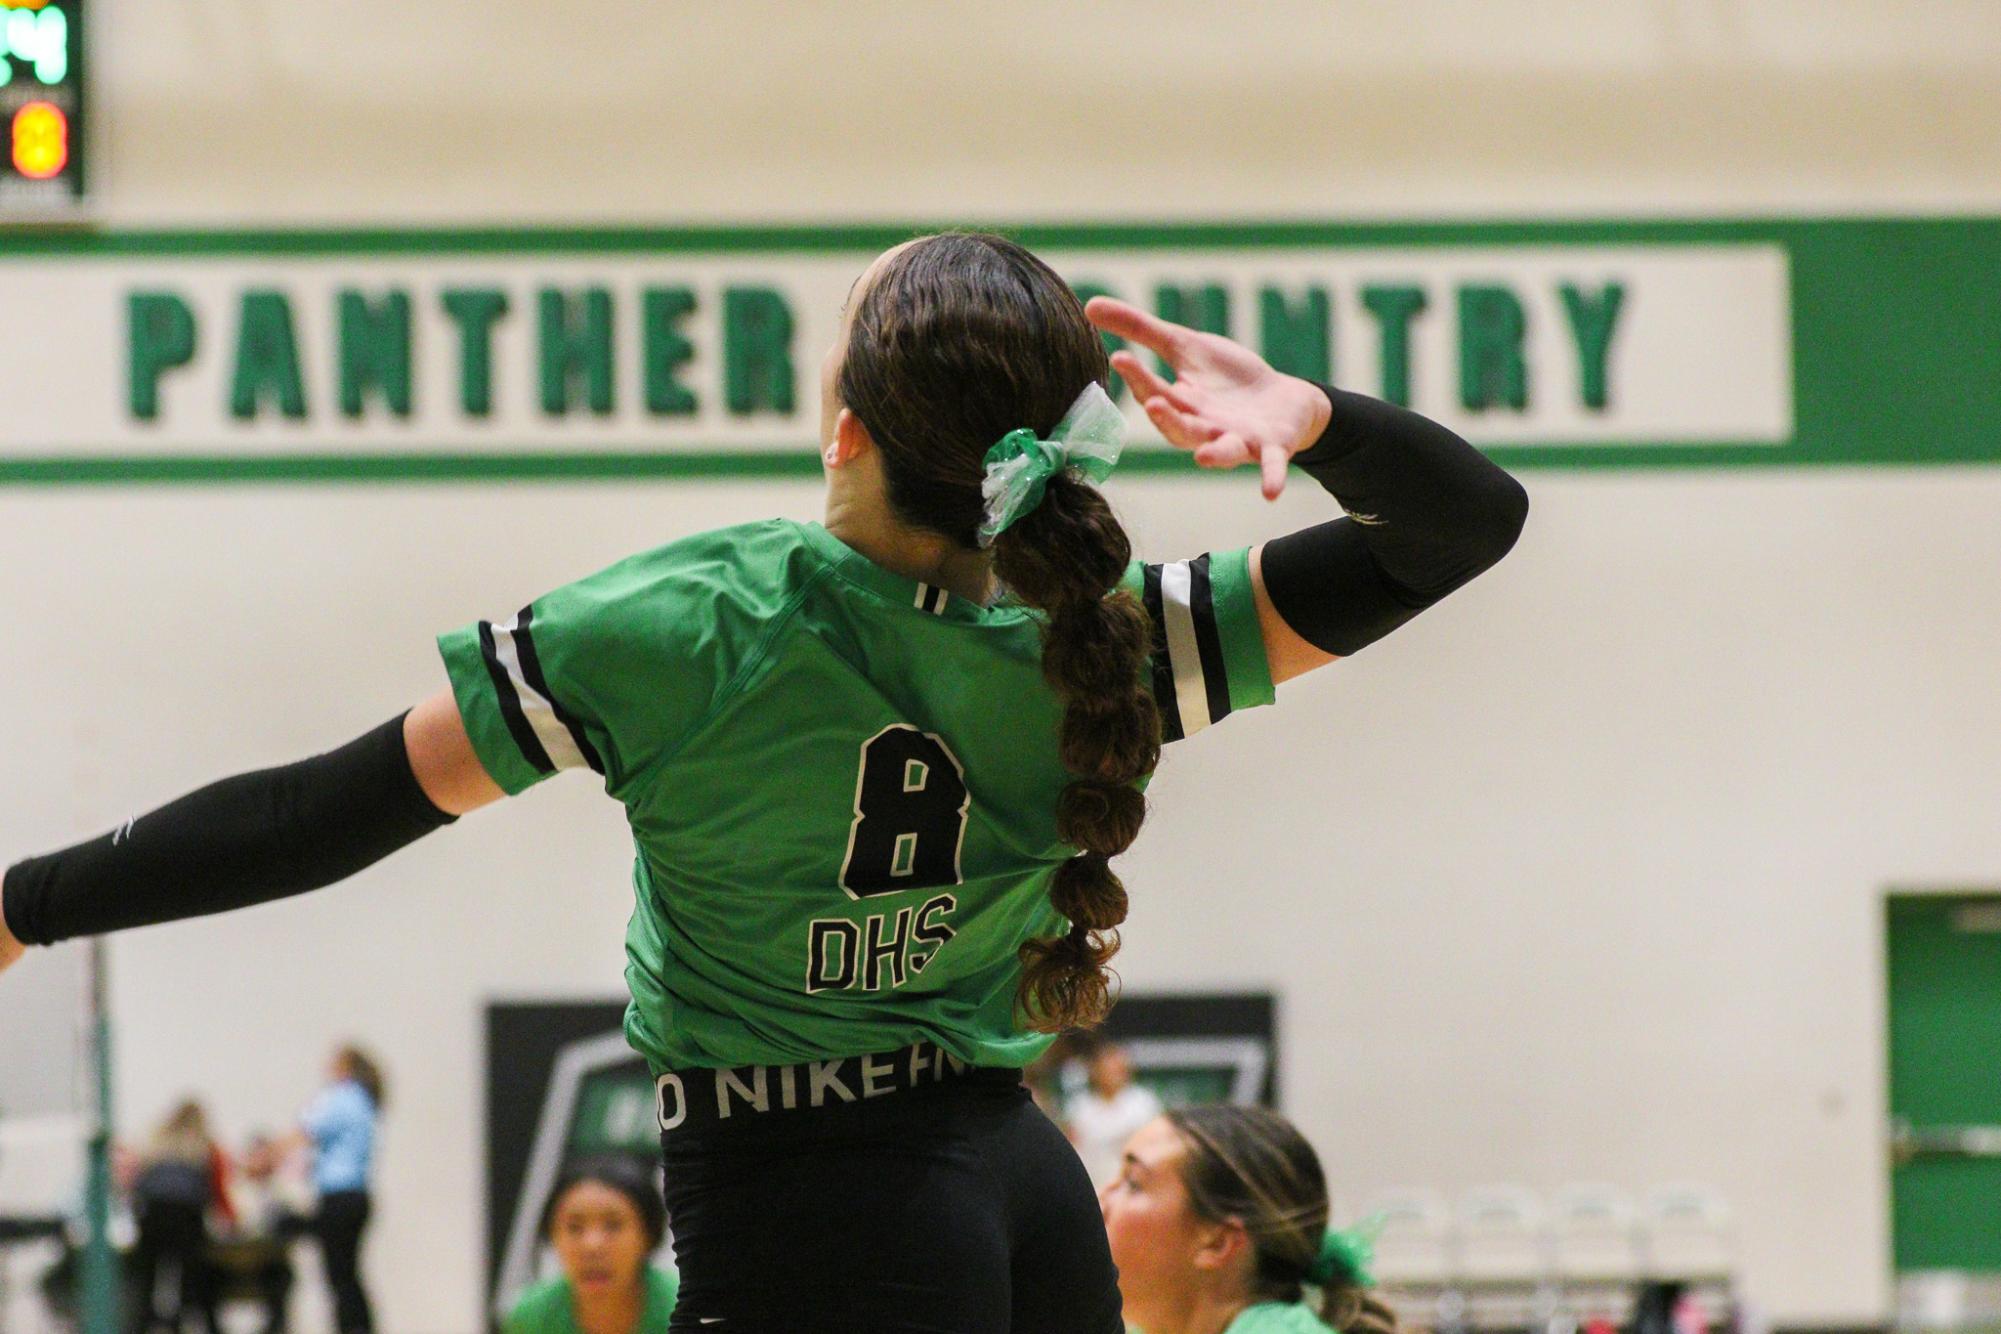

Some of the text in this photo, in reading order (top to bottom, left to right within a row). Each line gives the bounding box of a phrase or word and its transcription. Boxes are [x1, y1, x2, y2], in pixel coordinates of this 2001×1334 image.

[127, 282, 1625, 419] PANTHER UNTRY
[839, 723, 971, 900] 8
[806, 893, 957, 994] DHS
[654, 1073, 687, 1131] O
[716, 1054, 897, 1119] NIKE
